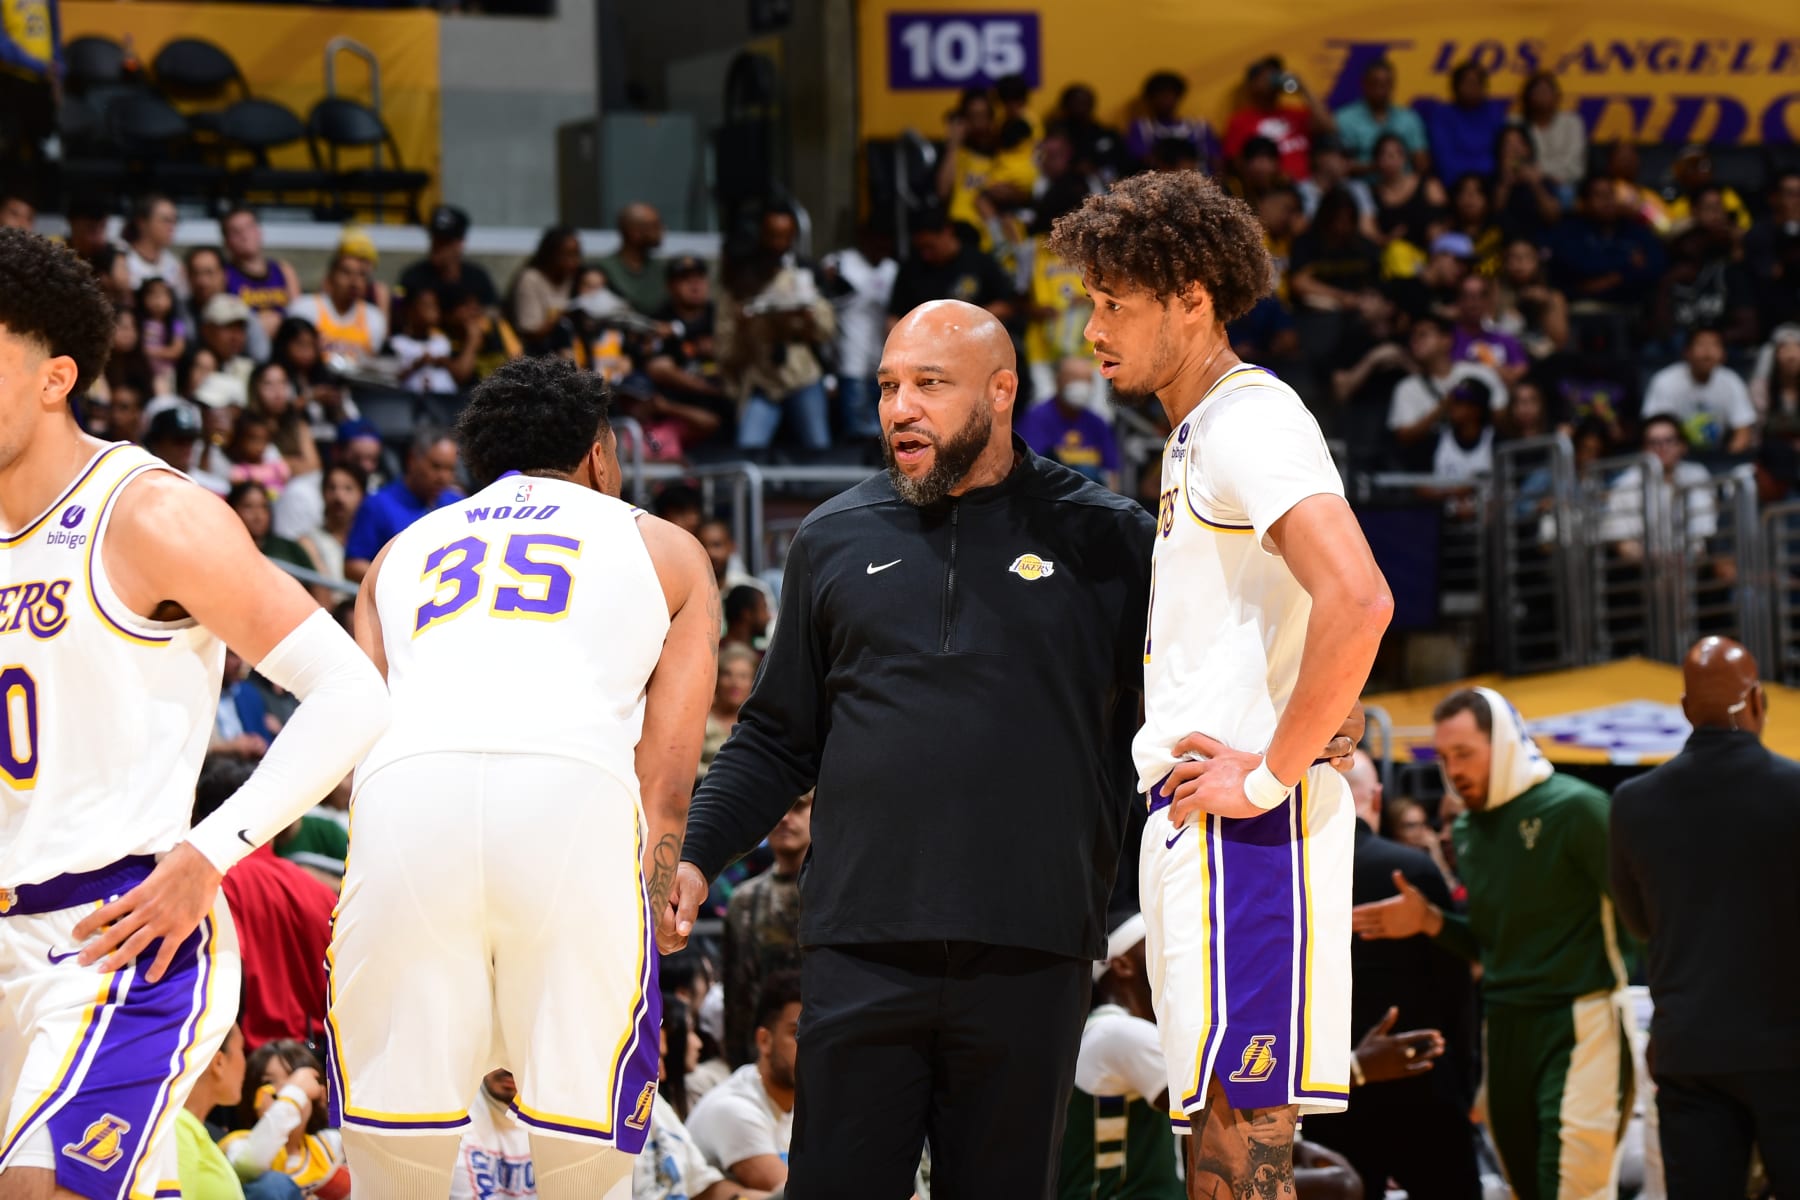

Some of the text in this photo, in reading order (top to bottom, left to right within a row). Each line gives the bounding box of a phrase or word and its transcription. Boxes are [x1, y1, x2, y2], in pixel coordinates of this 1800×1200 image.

[901, 20, 1026, 81] 105
[46, 531, 87, 549] bibigo
[464, 505, 561, 524] WOOD
[0, 577, 72, 639] ERS
[411, 531, 584, 640] 35
